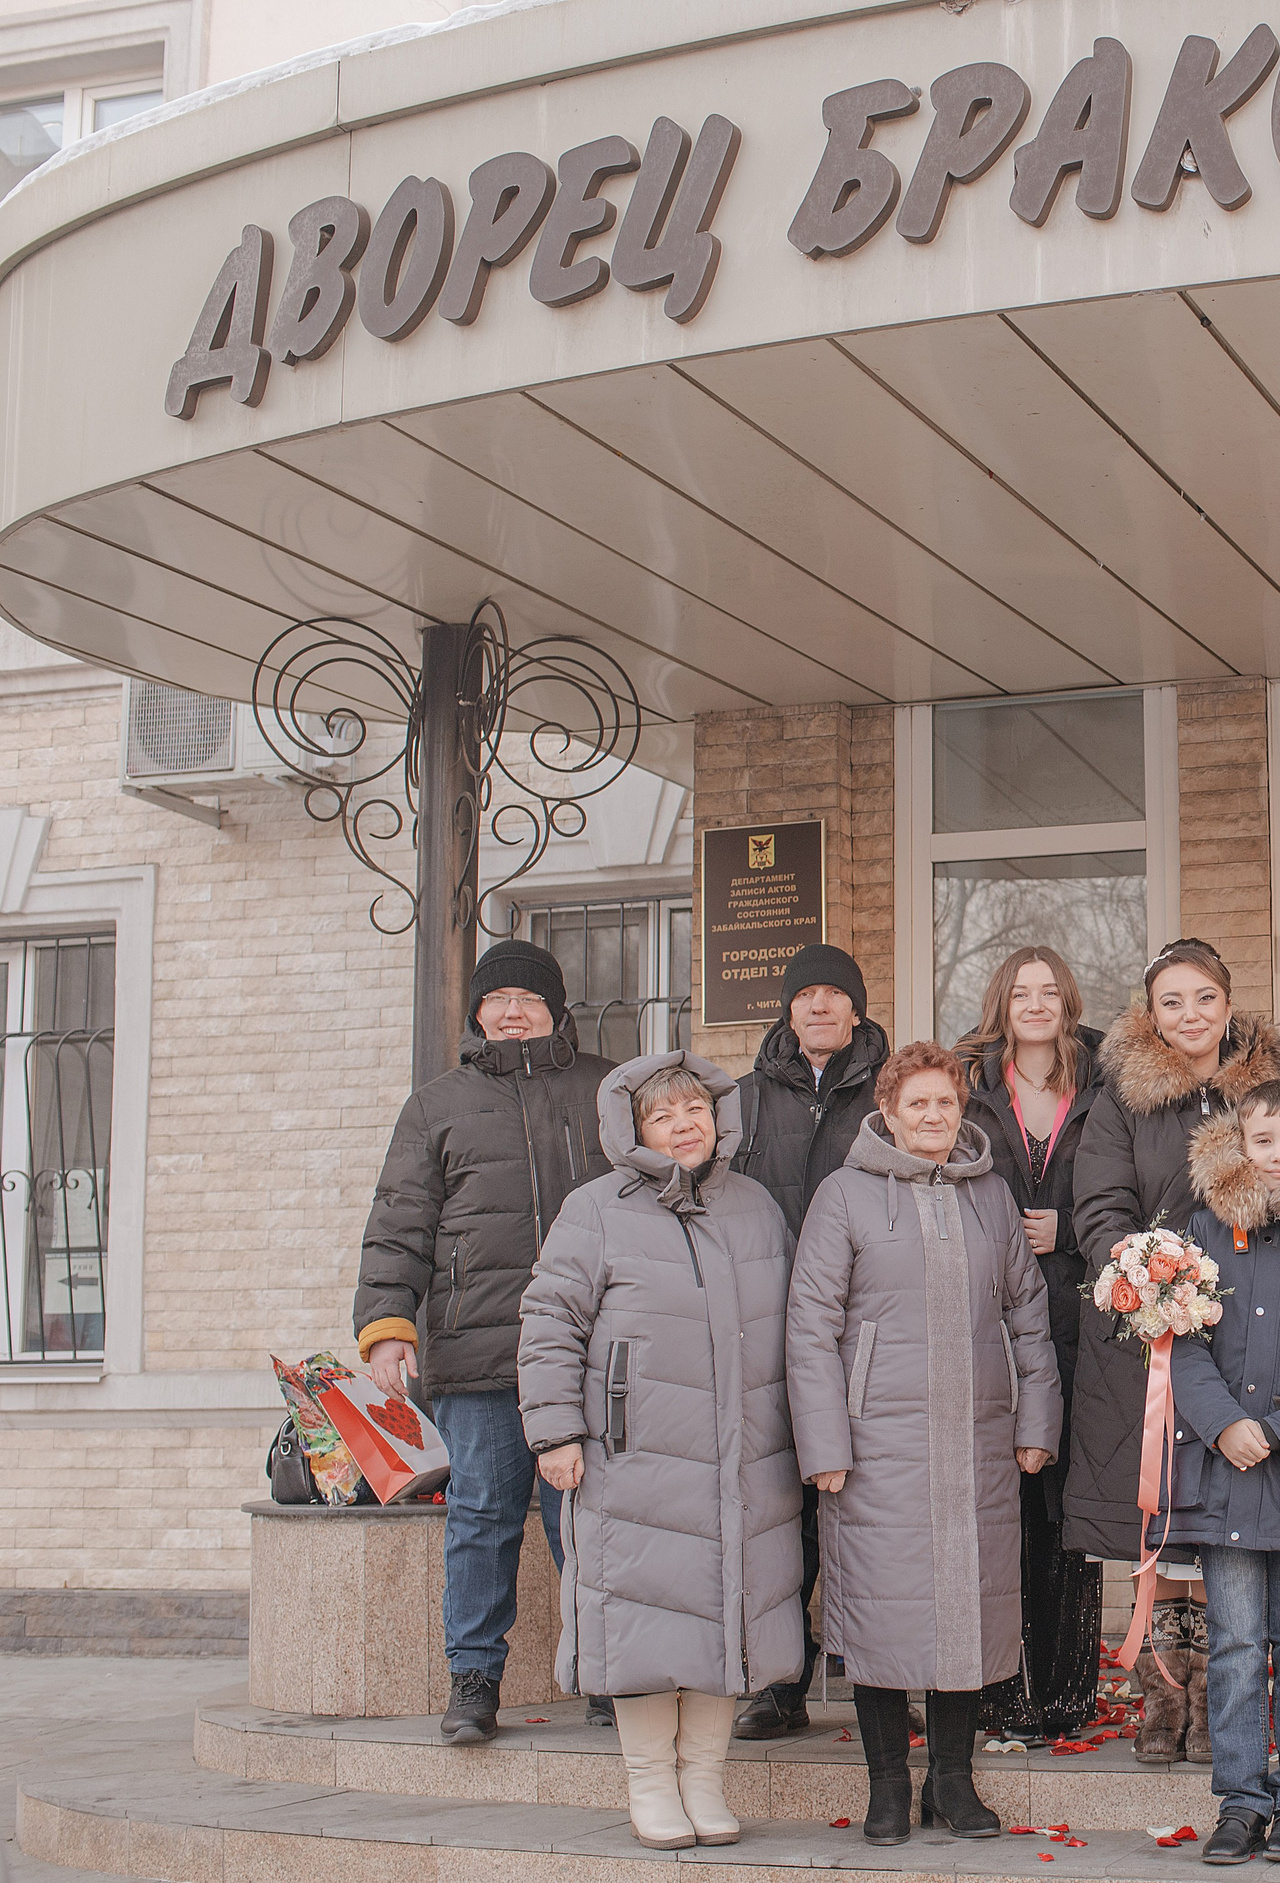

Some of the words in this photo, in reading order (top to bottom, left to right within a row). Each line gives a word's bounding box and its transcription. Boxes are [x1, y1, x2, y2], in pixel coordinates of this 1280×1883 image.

[164, 113, 743, 421] ДВОРЕЦ
[731, 873, 796, 887] ДЕПАРТАМЕНТ
[730, 886, 765, 898] ЗАПИСИ
[767, 884, 797, 895] АКТОВ
[728, 895, 799, 908] ГРАЖДАНСКОГО
[737, 907, 791, 919] СОСТОЯНИЯ
[711, 918, 791, 933] ЗАБАЙКАЛЬСКОГО
[793, 916, 817, 926] КРАЯ
[722, 966, 768, 981] ОТДЕЛ
[772, 964, 787, 976] ЗА
[747, 1003, 755, 1011] г.
[756, 999, 782, 1010] ЧИТА
